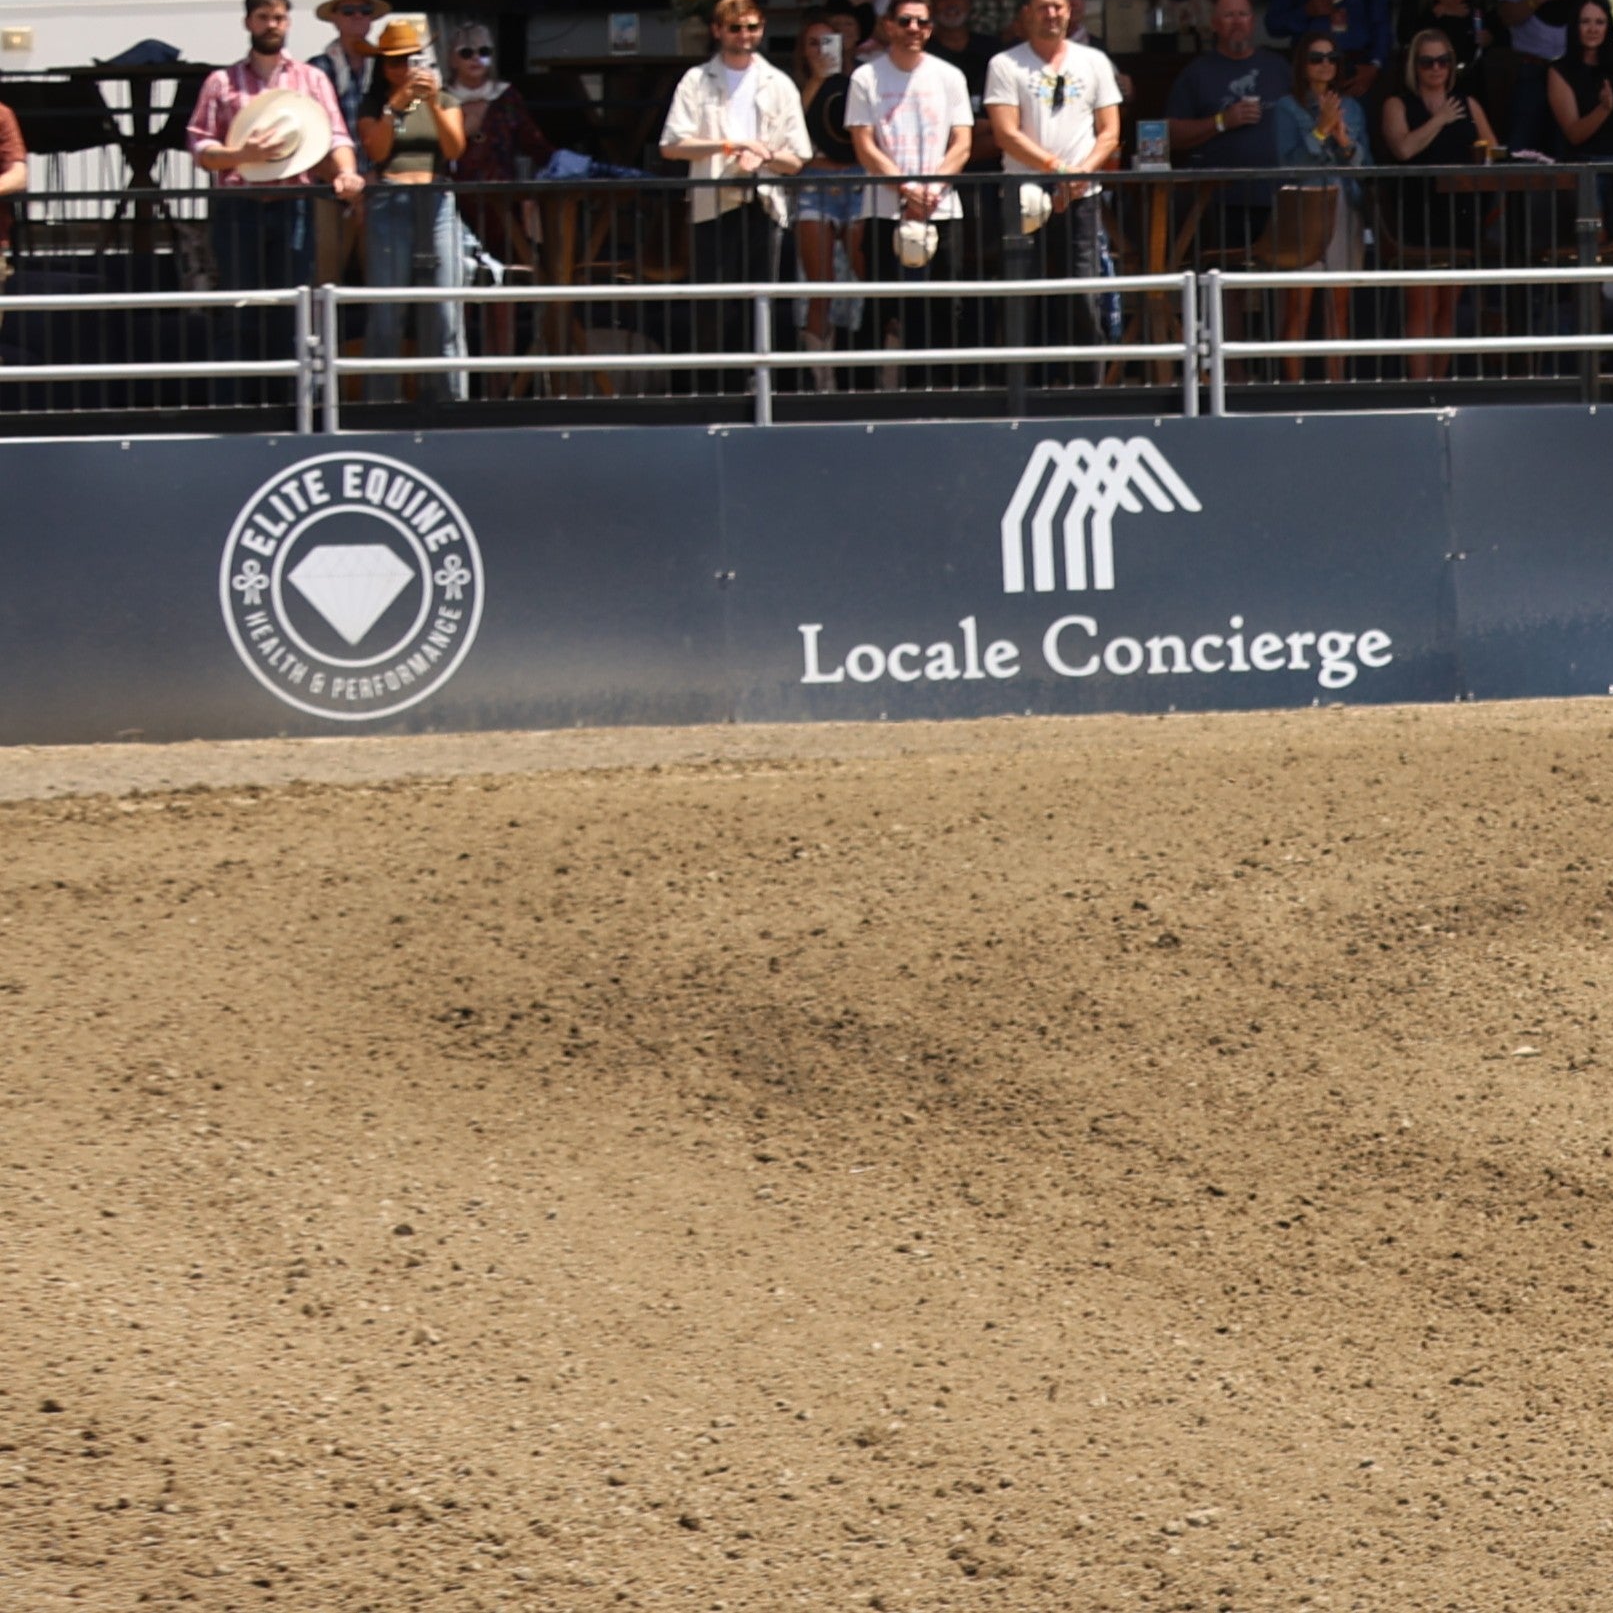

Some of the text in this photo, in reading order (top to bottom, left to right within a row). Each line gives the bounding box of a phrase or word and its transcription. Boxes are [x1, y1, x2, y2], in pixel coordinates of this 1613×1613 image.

[239, 463, 461, 557] ELITE EQUINE
[244, 609, 309, 685] HEALTH
[330, 604, 463, 701] PERFORMANCE
[797, 614, 1394, 689] Locale Concierge
